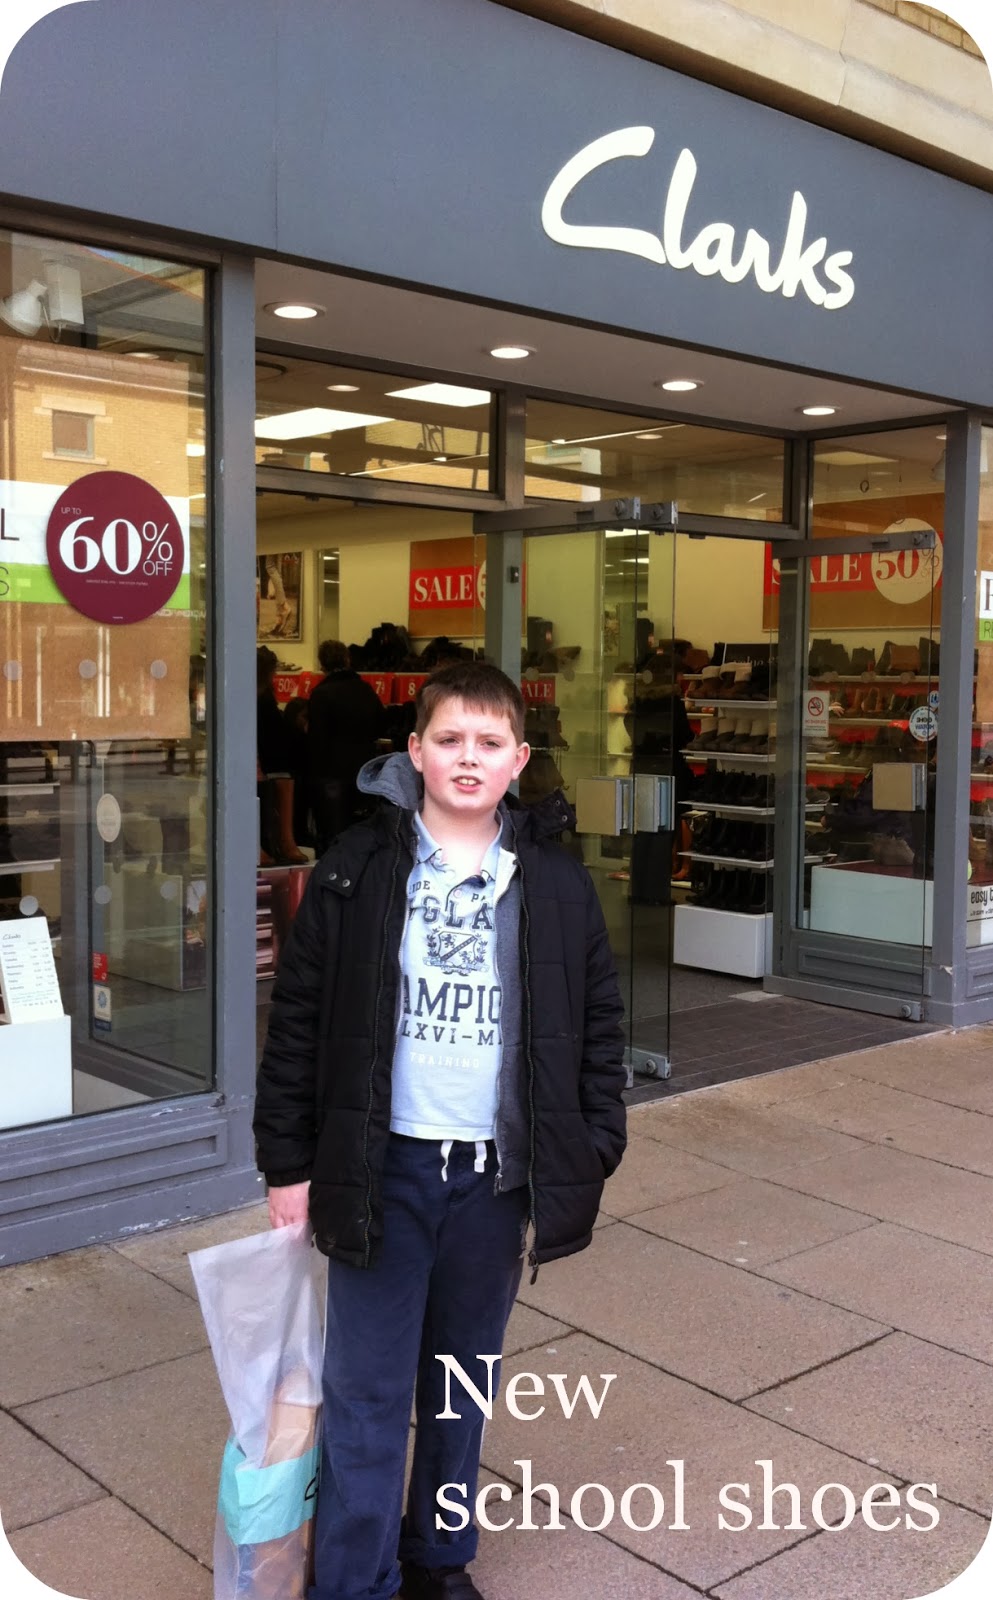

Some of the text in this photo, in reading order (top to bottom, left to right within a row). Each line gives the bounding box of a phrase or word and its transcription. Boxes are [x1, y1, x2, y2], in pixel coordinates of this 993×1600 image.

[541, 126, 855, 310] Clarks
[72, 507, 82, 515] TO
[59, 516, 173, 576] 60%
[143, 560, 173, 576] OFF
[413, 574, 473, 603] SALE
[408, 682, 416, 696] 8
[522, 683, 553, 698] ALE
[408, 880, 431, 895] IDE
[971, 891, 988, 906] easy
[407, 895, 494, 930] GLA
[402, 1020, 502, 1046] LXVI-M
